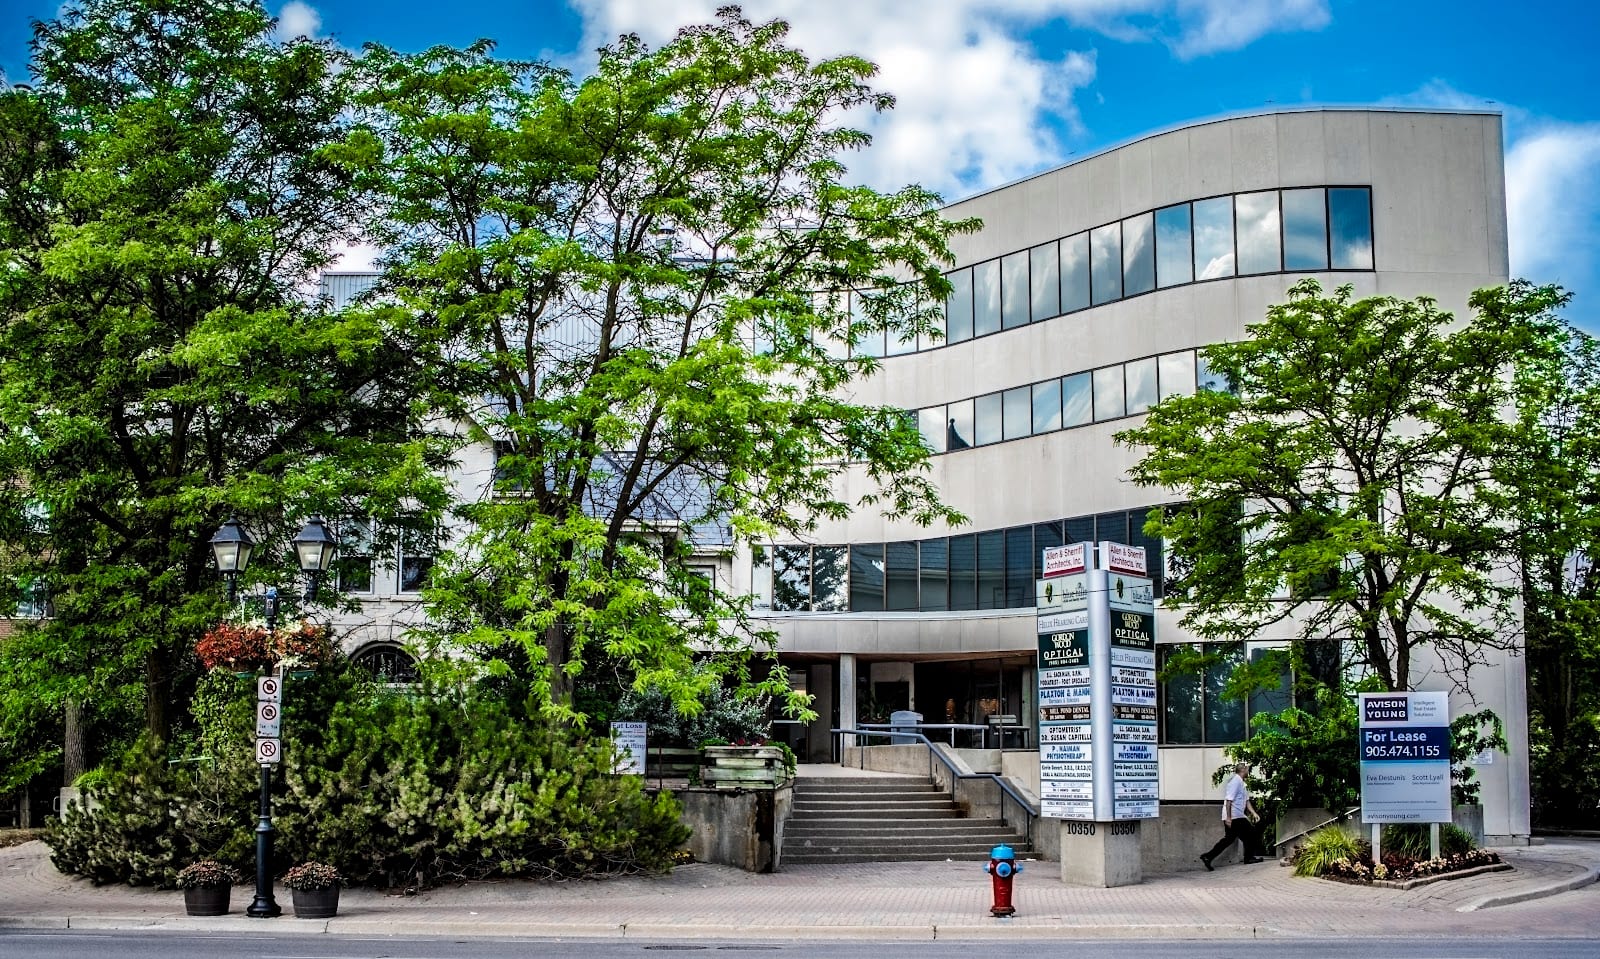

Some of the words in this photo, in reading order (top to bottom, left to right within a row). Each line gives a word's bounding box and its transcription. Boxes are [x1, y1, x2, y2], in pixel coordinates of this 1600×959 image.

[1110, 545, 1121, 555] Allen
[1046, 551, 1059, 560] Allen
[1115, 628, 1149, 641] OPTICAL
[1043, 648, 1084, 660] OPTICAL
[1040, 689, 1065, 699] PLAXTON
[1112, 687, 1135, 697] PLAXTON
[1367, 710, 1406, 718] YOUNG
[1049, 726, 1081, 734] OPTOMETRIST
[1365, 731, 1387, 742] For
[1389, 731, 1427, 742] Lease
[1046, 752, 1086, 760] PHYSIOTHERAPY
[1118, 752, 1152, 760] PHYSIOTHERAPY
[1365, 745, 1440, 757] 905.474.1155
[1067, 823, 1096, 836] 10350
[1111, 823, 1135, 836] 10350
